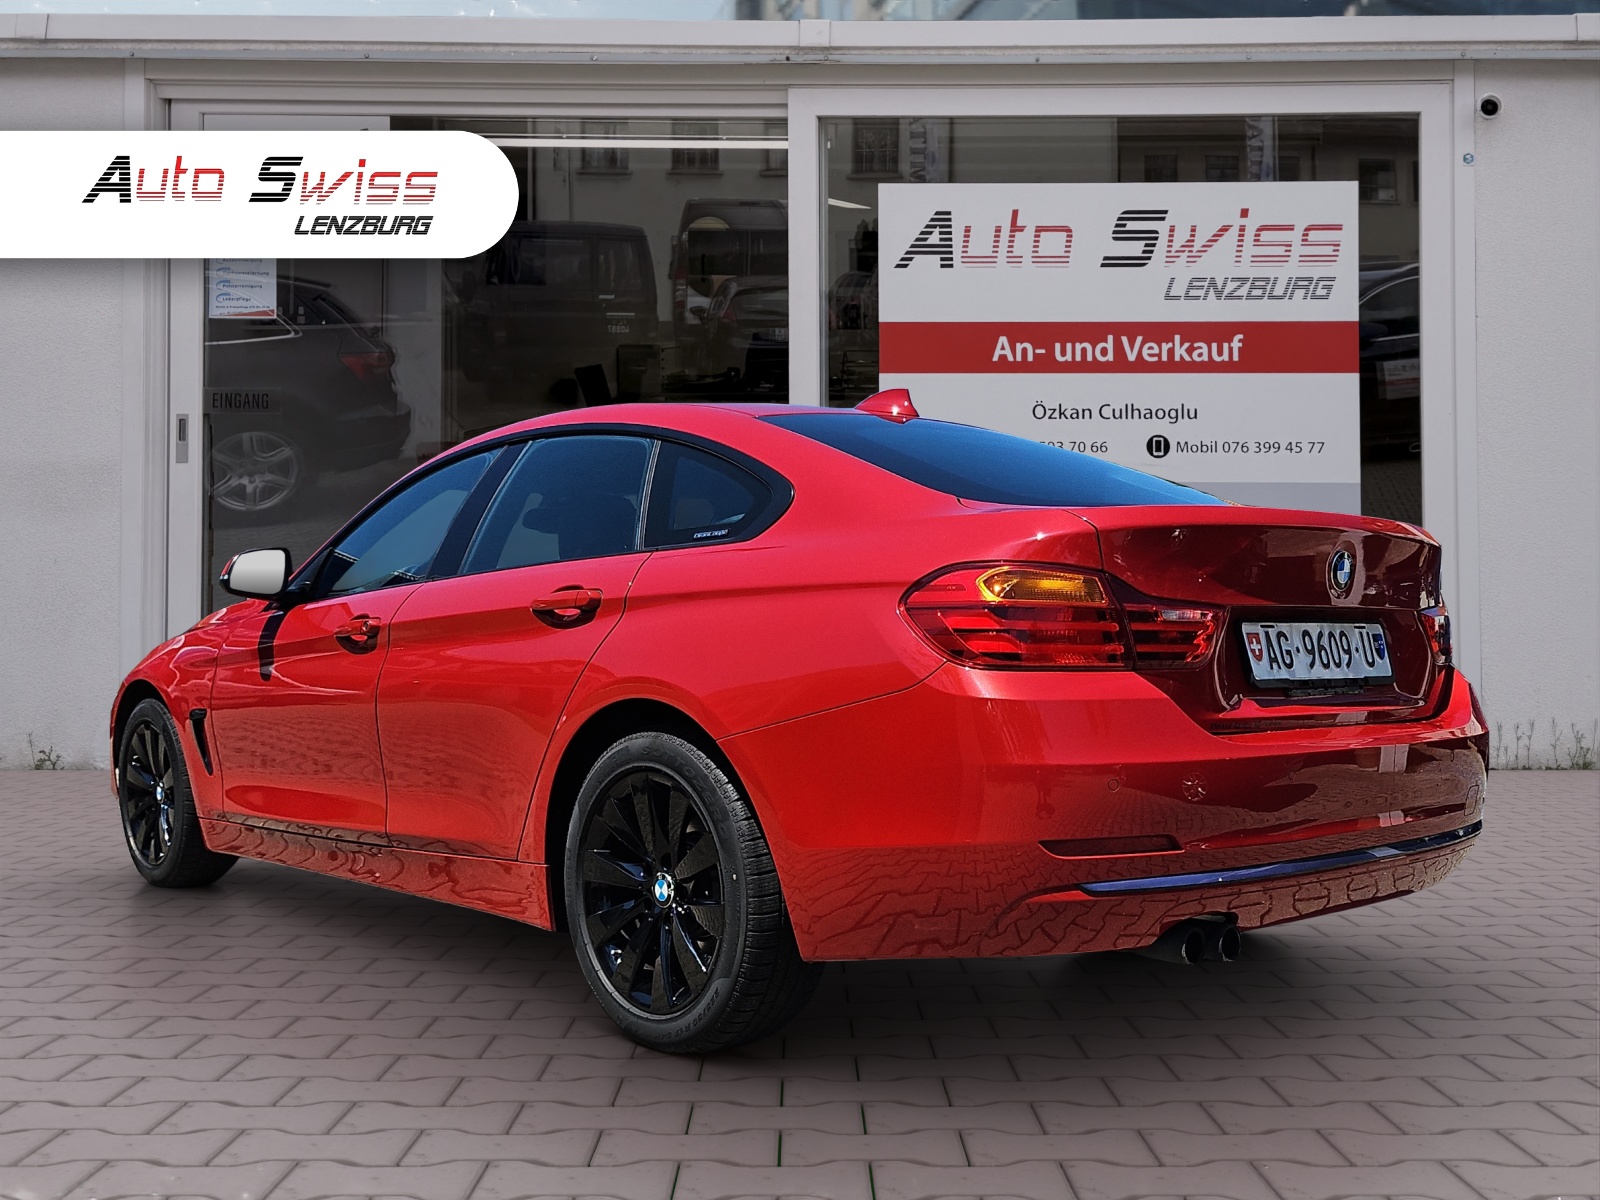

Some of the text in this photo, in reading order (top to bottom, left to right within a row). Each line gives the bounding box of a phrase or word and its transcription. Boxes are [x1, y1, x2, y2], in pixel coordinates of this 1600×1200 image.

[894, 208, 1343, 269] Auto Swiss
[1164, 276, 1336, 301] LENZBURG
[992, 334, 1244, 362] An- und Verkauf
[212, 392, 269, 409] EINGANG
[1032, 400, 1198, 424] Özkan Culhaoglu
[1069, 441, 1086, 453] 70
[1090, 441, 1108, 453] 66
[1176, 440, 1325, 454] Mobil 076 399 45 77
